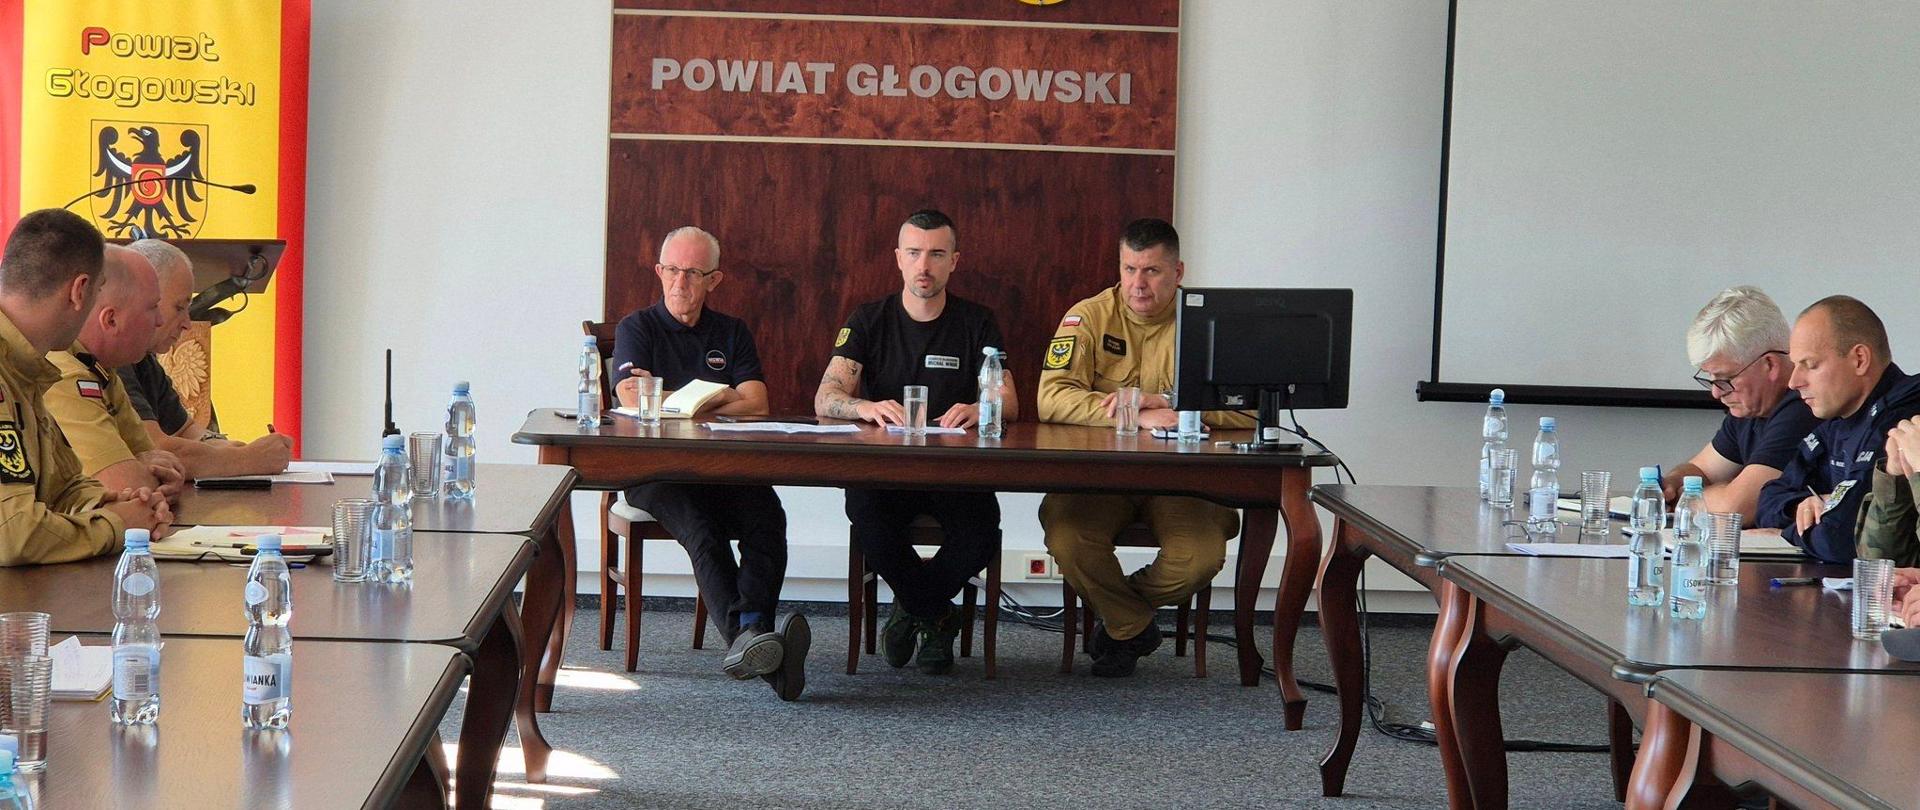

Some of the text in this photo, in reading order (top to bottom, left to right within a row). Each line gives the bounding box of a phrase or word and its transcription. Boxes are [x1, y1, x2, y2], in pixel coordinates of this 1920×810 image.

[81, 26, 220, 62] Powiat
[45, 67, 255, 108] Głogowski
[651, 57, 1132, 105] POWIAT GŁOGOWSKI
